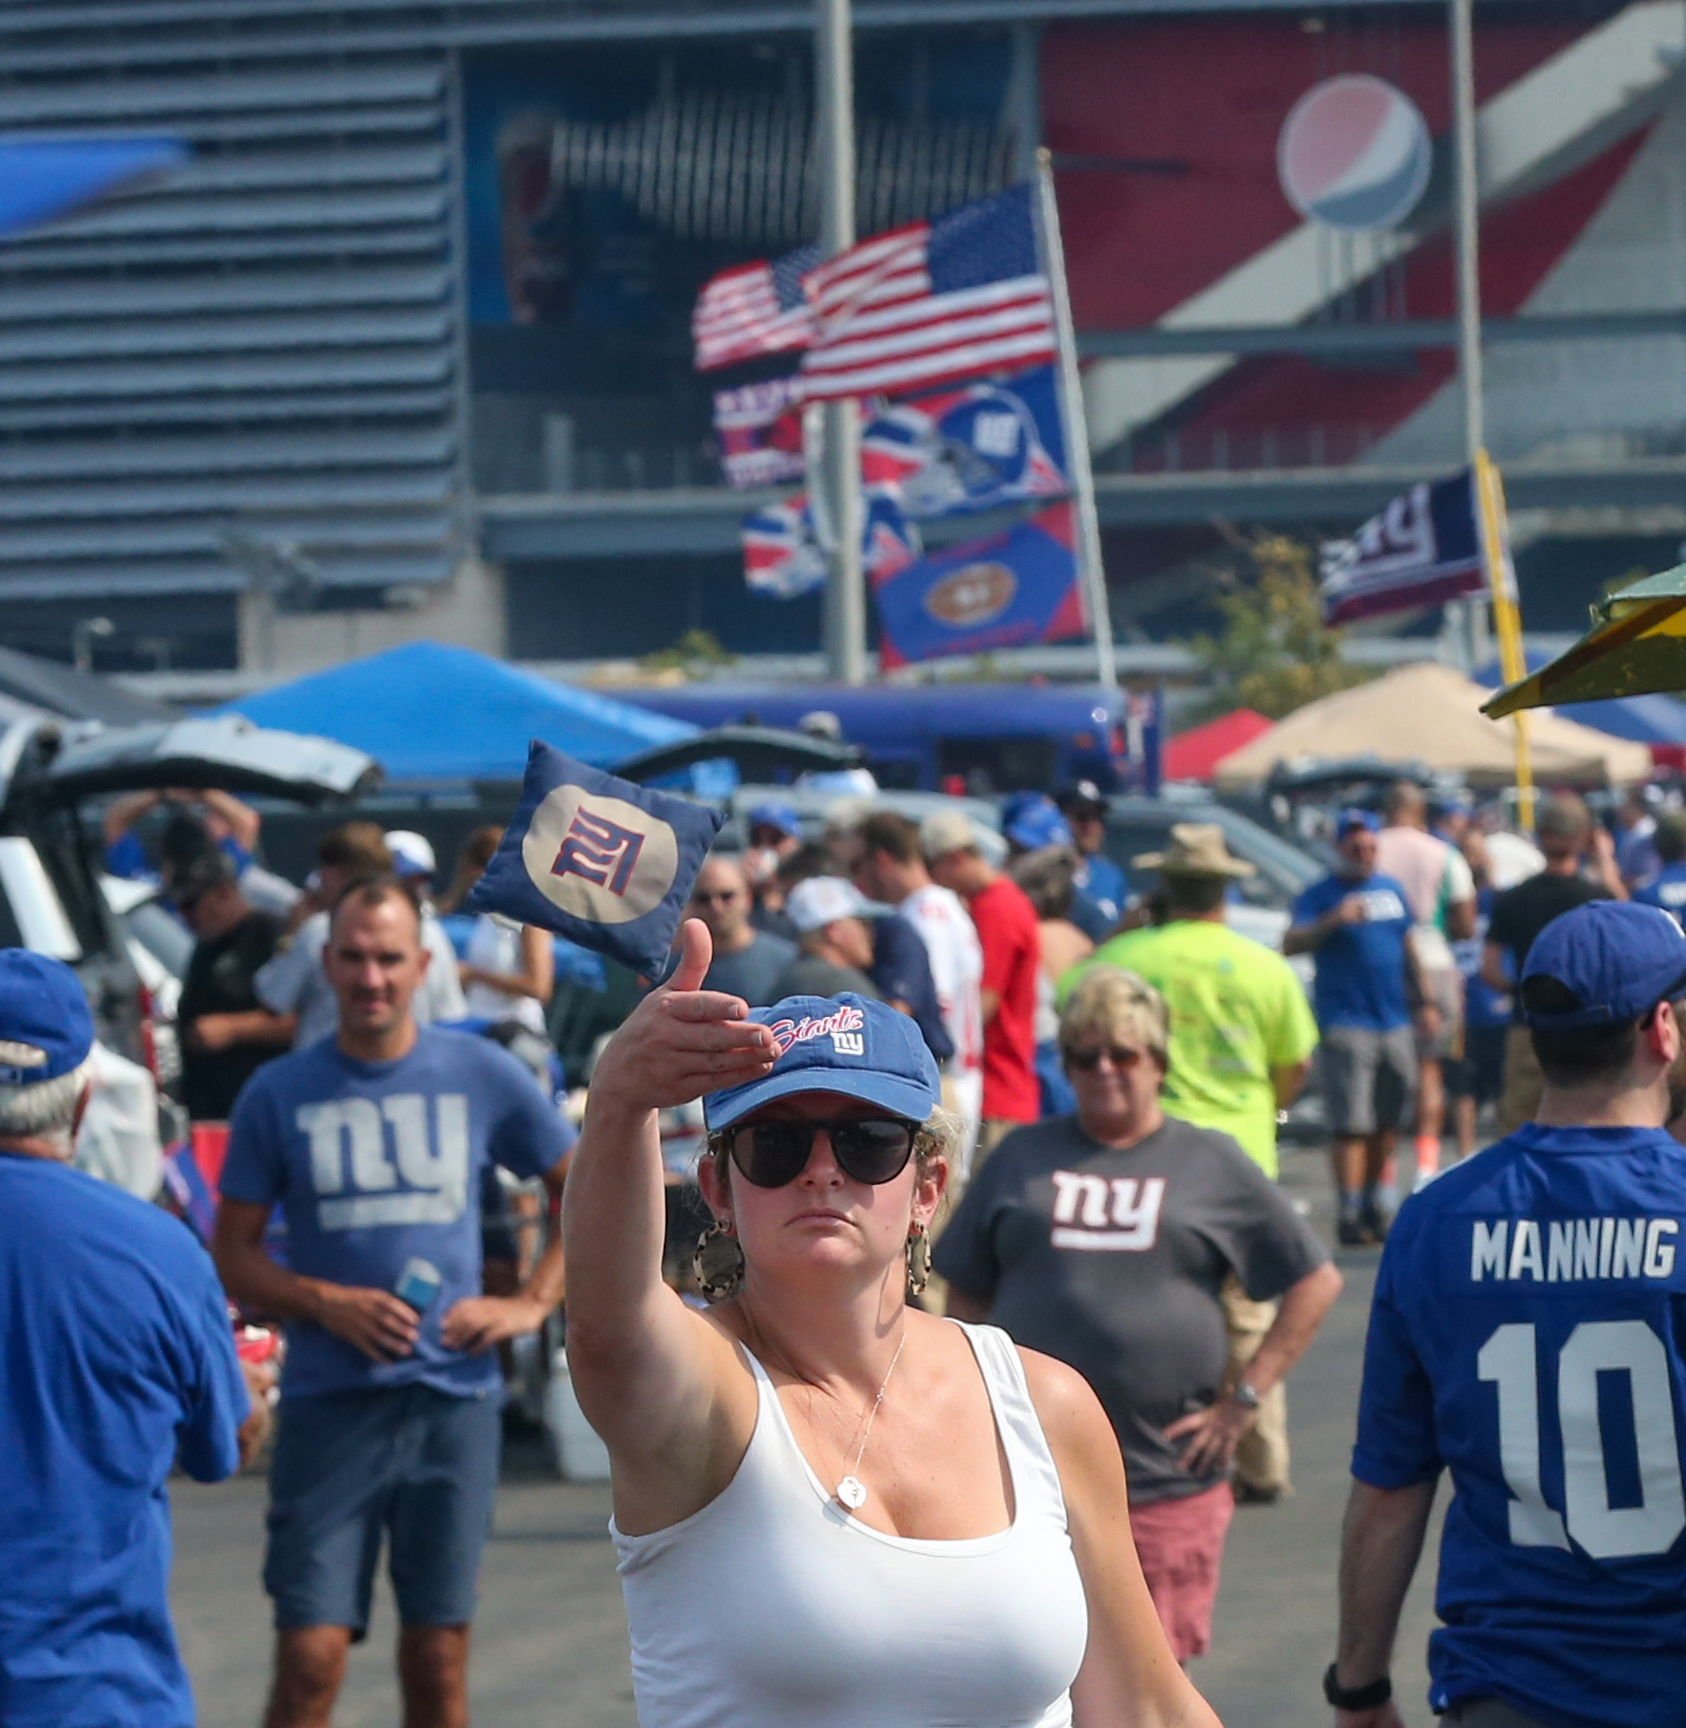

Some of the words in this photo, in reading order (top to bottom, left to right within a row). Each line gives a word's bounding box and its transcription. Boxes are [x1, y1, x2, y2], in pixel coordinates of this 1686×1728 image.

[770, 1006, 864, 1057] Giants
[1471, 1217, 1679, 1283] MANNING
[1477, 1319, 1686, 1559] 10
